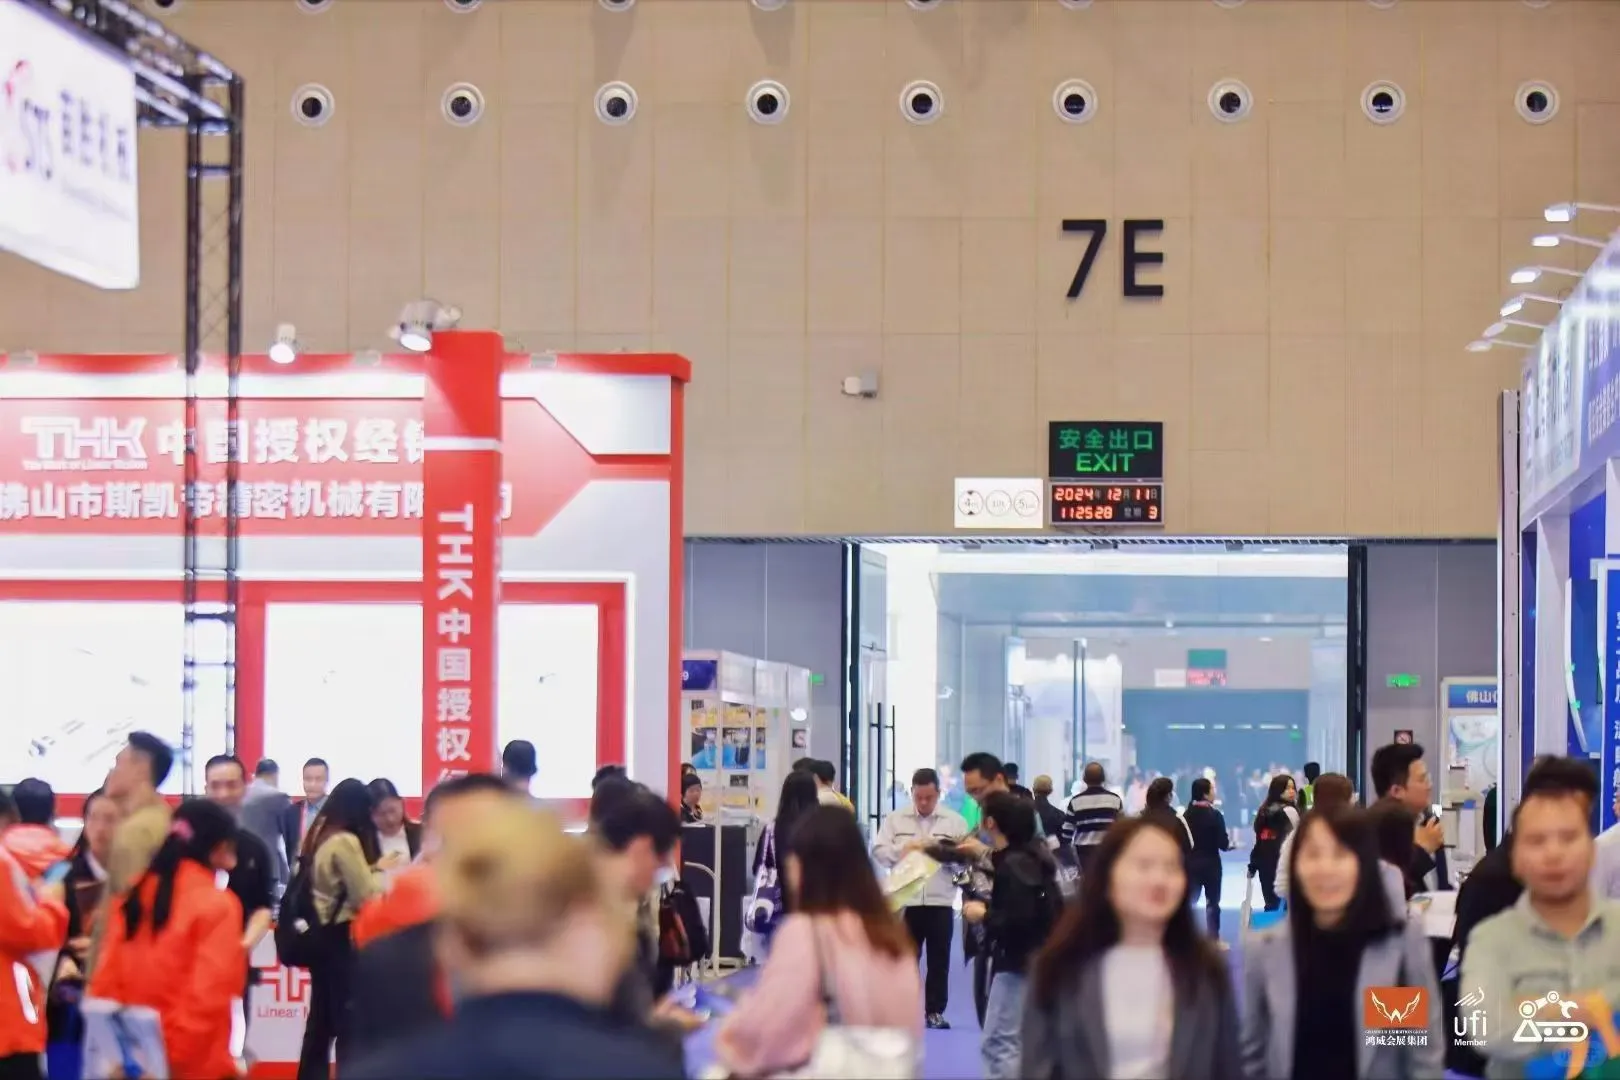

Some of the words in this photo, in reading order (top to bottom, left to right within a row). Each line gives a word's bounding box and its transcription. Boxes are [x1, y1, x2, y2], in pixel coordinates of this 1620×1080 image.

[1062, 219, 1164, 298] 7E
[20, 416, 147, 459] THK
[1058, 428, 1153, 450] 安全出口
[1075, 453, 1135, 472] EXIT
[257, 1005, 298, 1018] Linear
